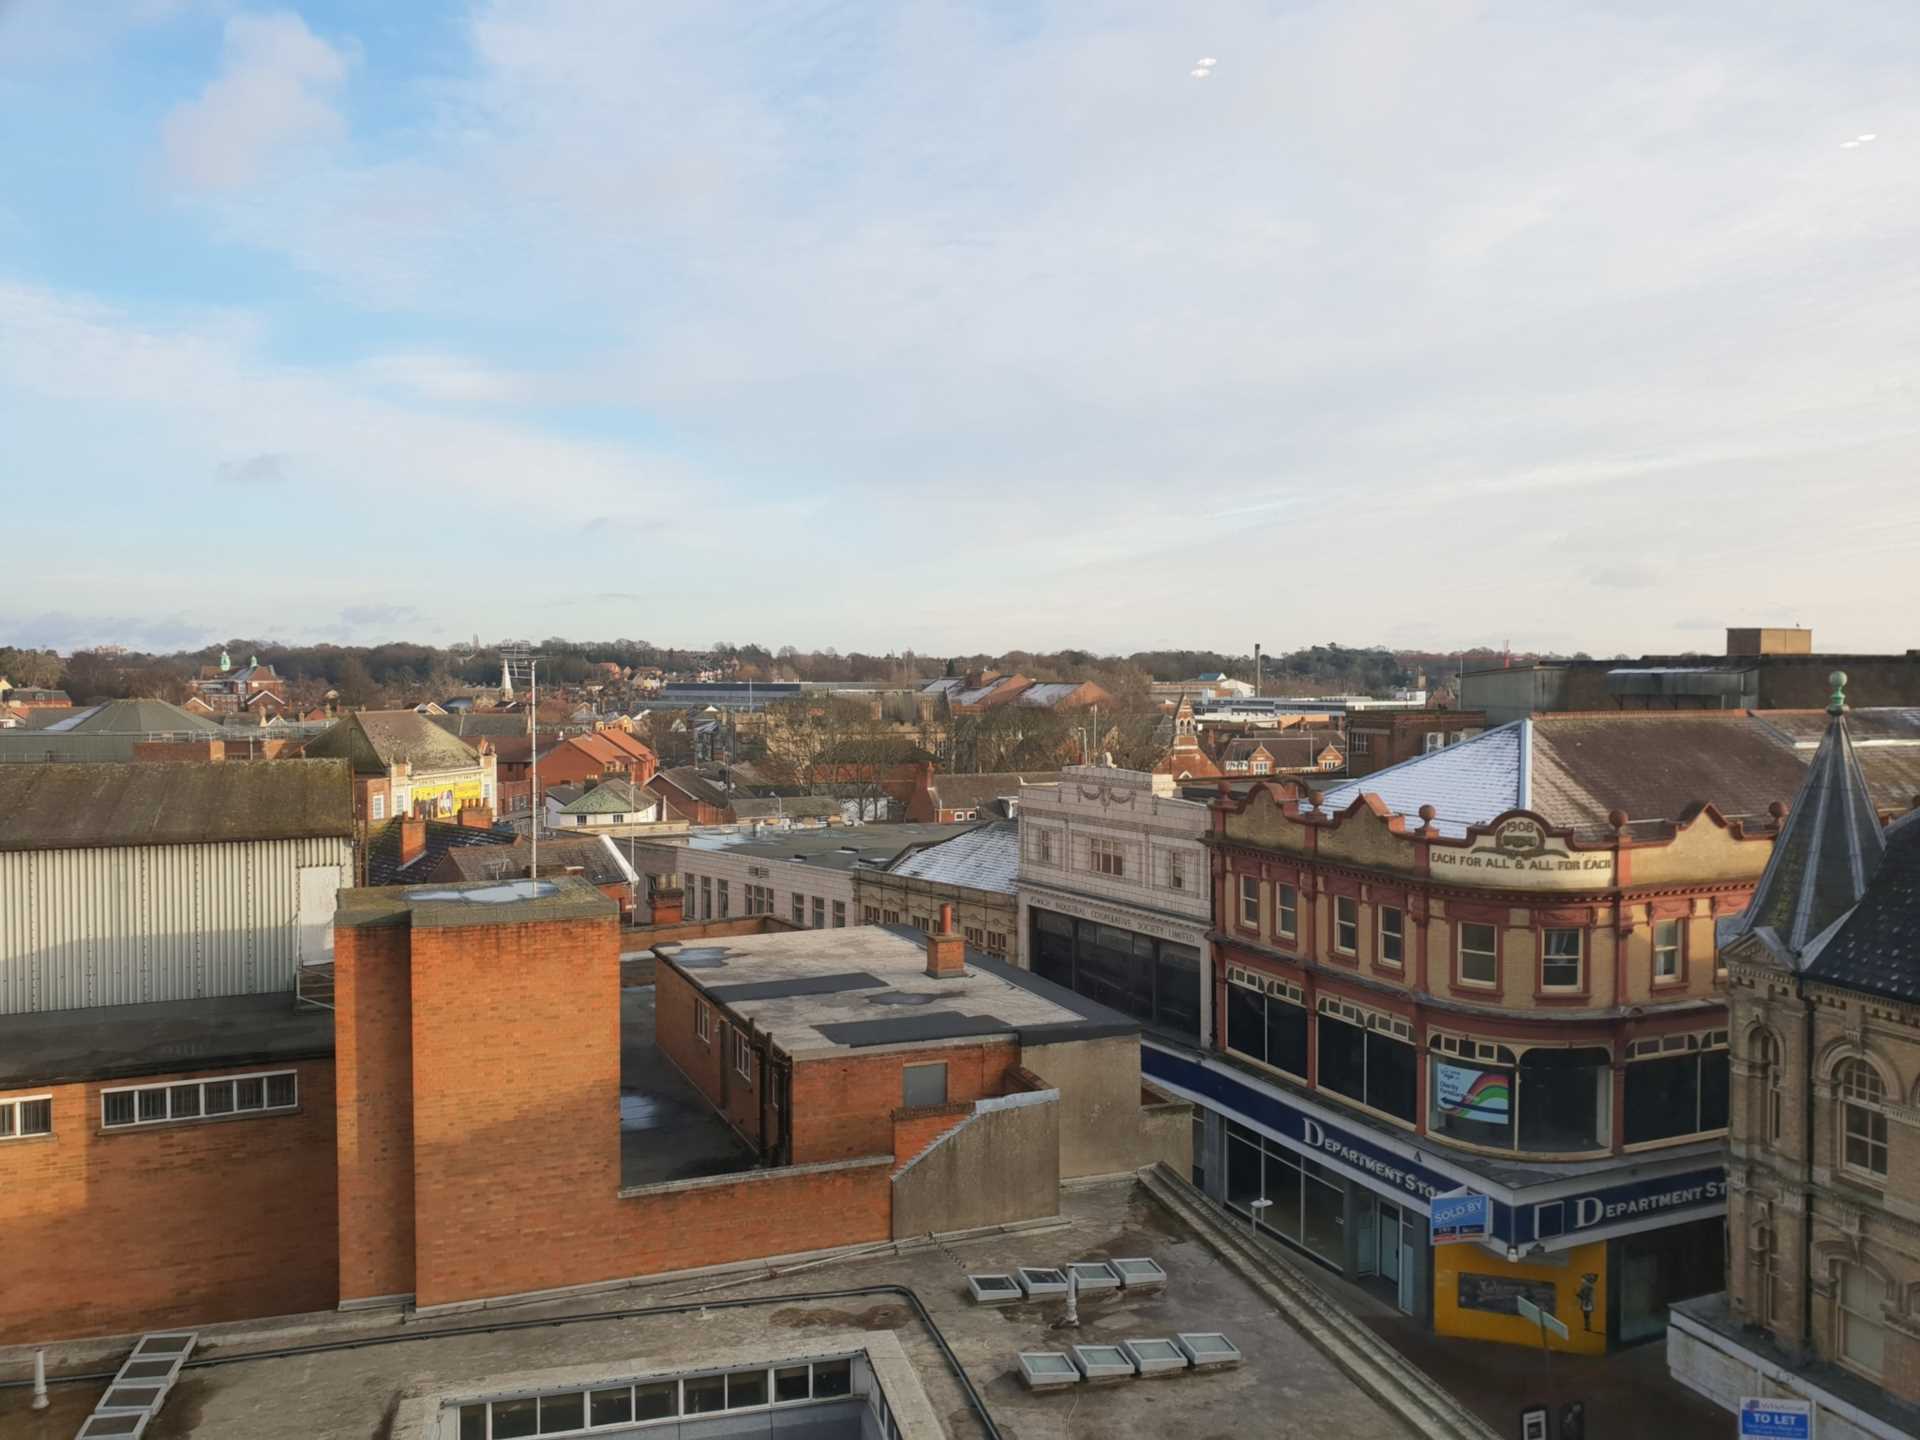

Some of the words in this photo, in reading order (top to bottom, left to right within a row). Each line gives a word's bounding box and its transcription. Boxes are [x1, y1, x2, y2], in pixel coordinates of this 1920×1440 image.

[1506, 821, 1534, 833] 1908
[1431, 852, 1456, 865] EACH
[1460, 855, 1481, 868] FOR
[1485, 858, 1510, 869] ALL
[1514, 859, 1525, 870] &
[1529, 860, 1553, 871] ALL
[1557, 860, 1581, 871] FOR
[1583, 859, 1612, 870] EACH
[1405, 1173, 1442, 1200] STO
[1705, 1181, 1728, 1197] ST
[1433, 1206, 1465, 1223] SOLD
[1467, 1199, 1483, 1213] BY
[1754, 1413, 1771, 1424] TO
[1774, 1414, 1796, 1425] LET
